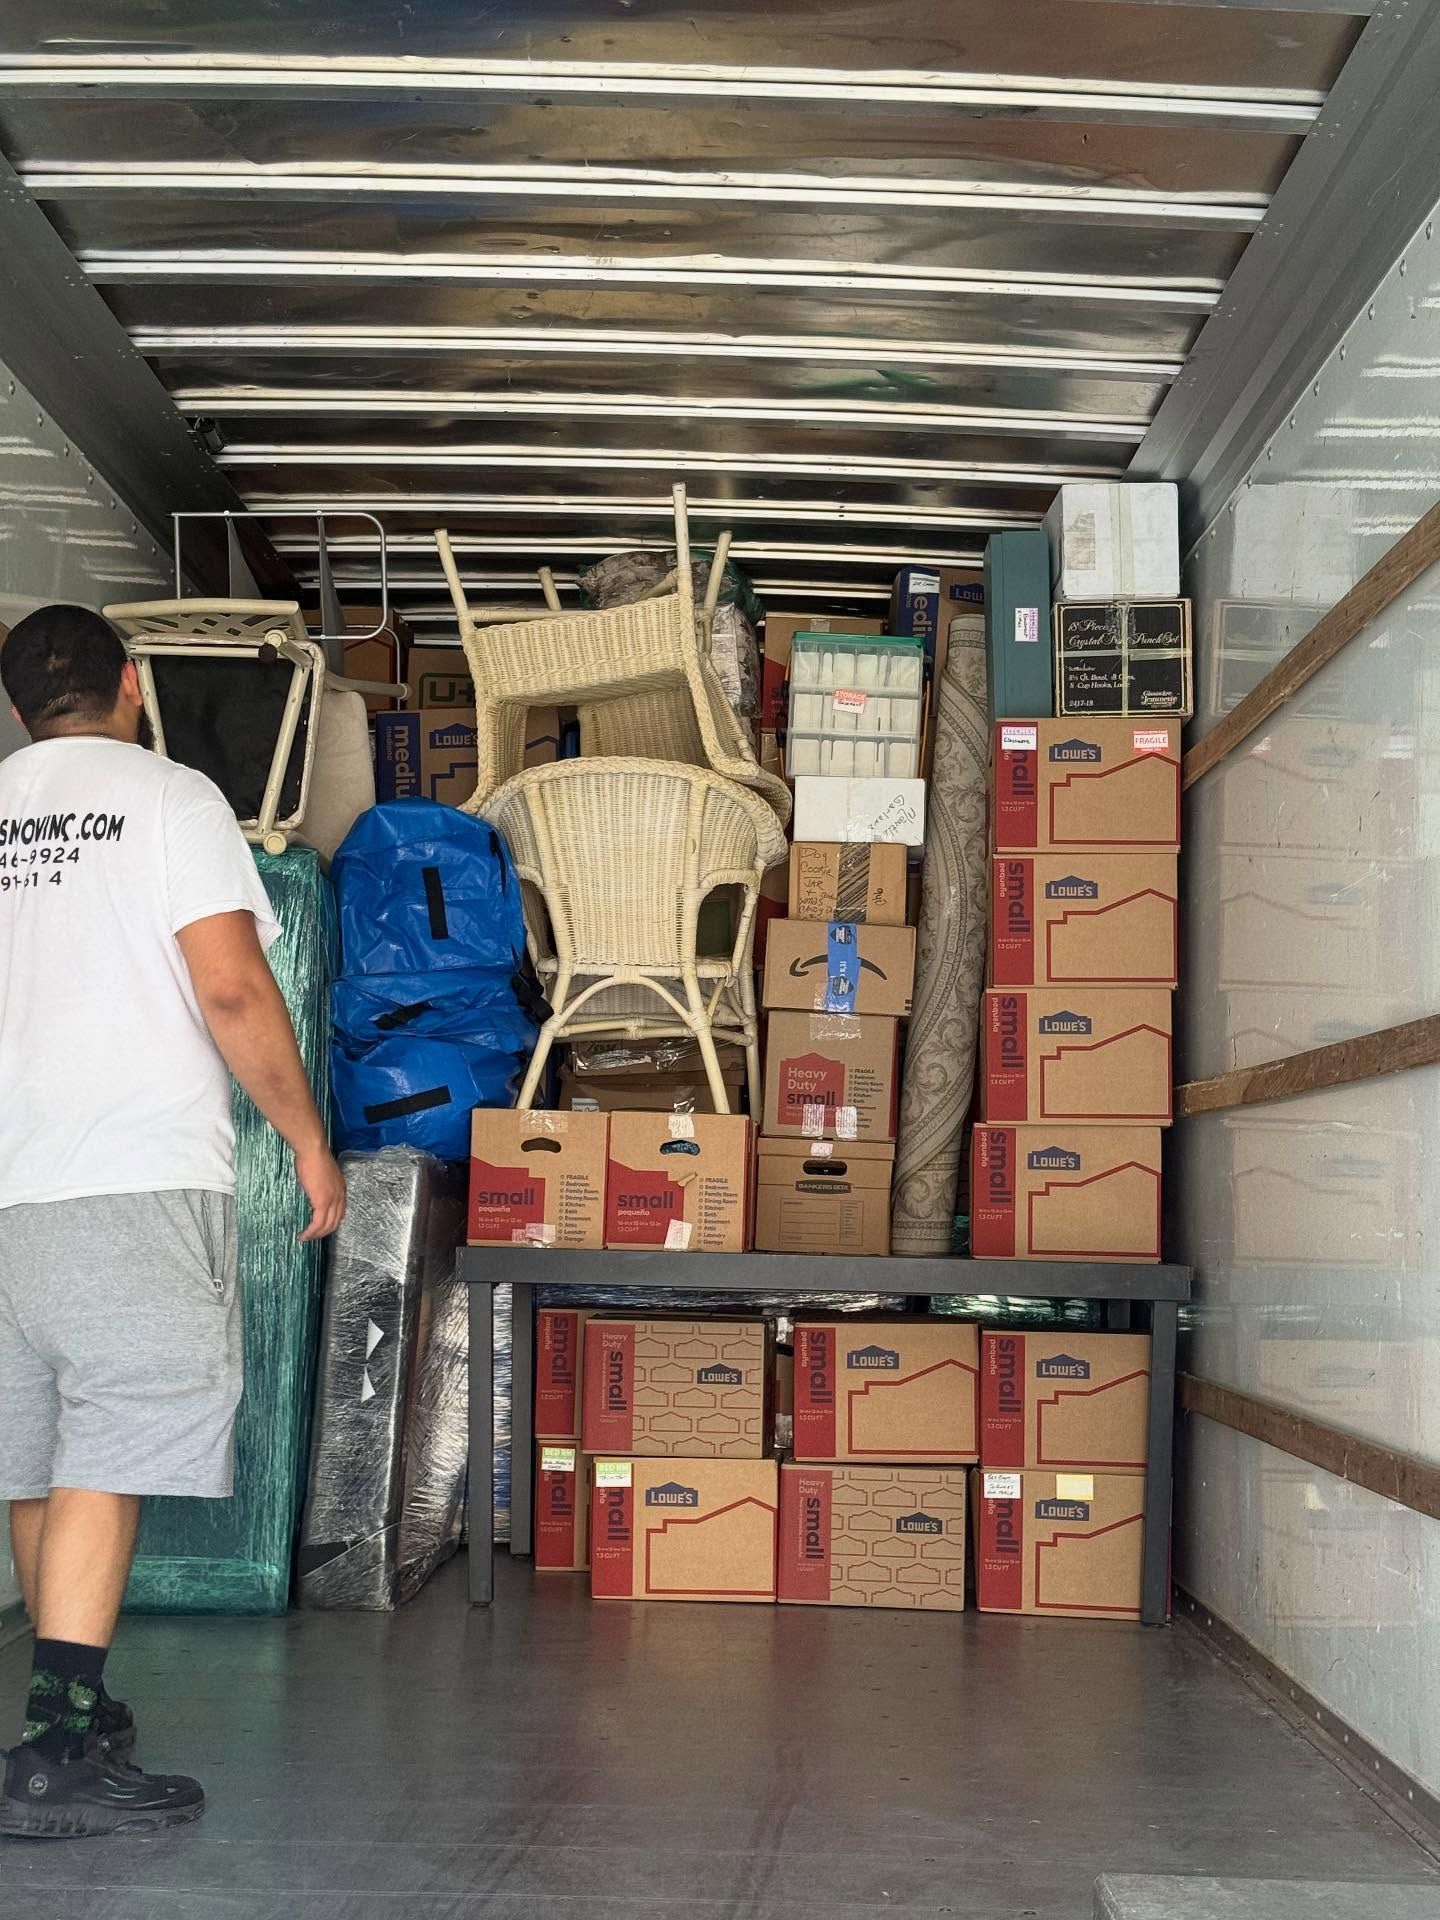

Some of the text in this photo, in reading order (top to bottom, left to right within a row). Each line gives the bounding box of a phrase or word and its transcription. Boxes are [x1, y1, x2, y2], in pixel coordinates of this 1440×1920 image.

[1131, 632, 1161, 645] Punch
[1135, 736, 1168, 746] FRAGILE
[1054, 748, 1096, 760] LOWE'S
[394, 726, 416, 798] mediu
[801, 847, 827, 865] Dog
[1009, 862, 1030, 932] small
[1050, 884, 1093, 897] LOWE'S
[1002, 996, 1024, 1068] small
[1044, 1019, 1087, 1032] LOWE'S
[788, 1067, 827, 1080] Heavy
[787, 1079, 817, 1092] Duty
[787, 1091, 836, 1106] small
[990, 1131, 1012, 1203] small
[1033, 1155, 1075, 1168] LOWE'S
[479, 1187, 535, 1206] small
[617, 1191, 673, 1208] small
[617, 1209, 650, 1217] pequeño
[602, 1332, 628, 1342] Heavy
[552, 1316, 573, 1385] small
[602, 1341, 622, 1349] Duty
[852, 1354, 894, 1367] LOWE'S
[810, 1332, 832, 1403] small
[1041, 1362, 1085, 1377] LOWE'S
[609, 1351, 627, 1411] small
[701, 1370, 738, 1383] LOWE'S
[999, 1339, 1022, 1413] small
[800, 1478, 825, 1487] Heavy
[800, 1486, 818, 1495] Duty
[651, 1491, 693, 1505] LOWE'S
[1040, 1503, 1085, 1519] LOWE'S
[806, 1497, 824, 1560] small
[900, 1520, 938, 1533] LOWE'S
